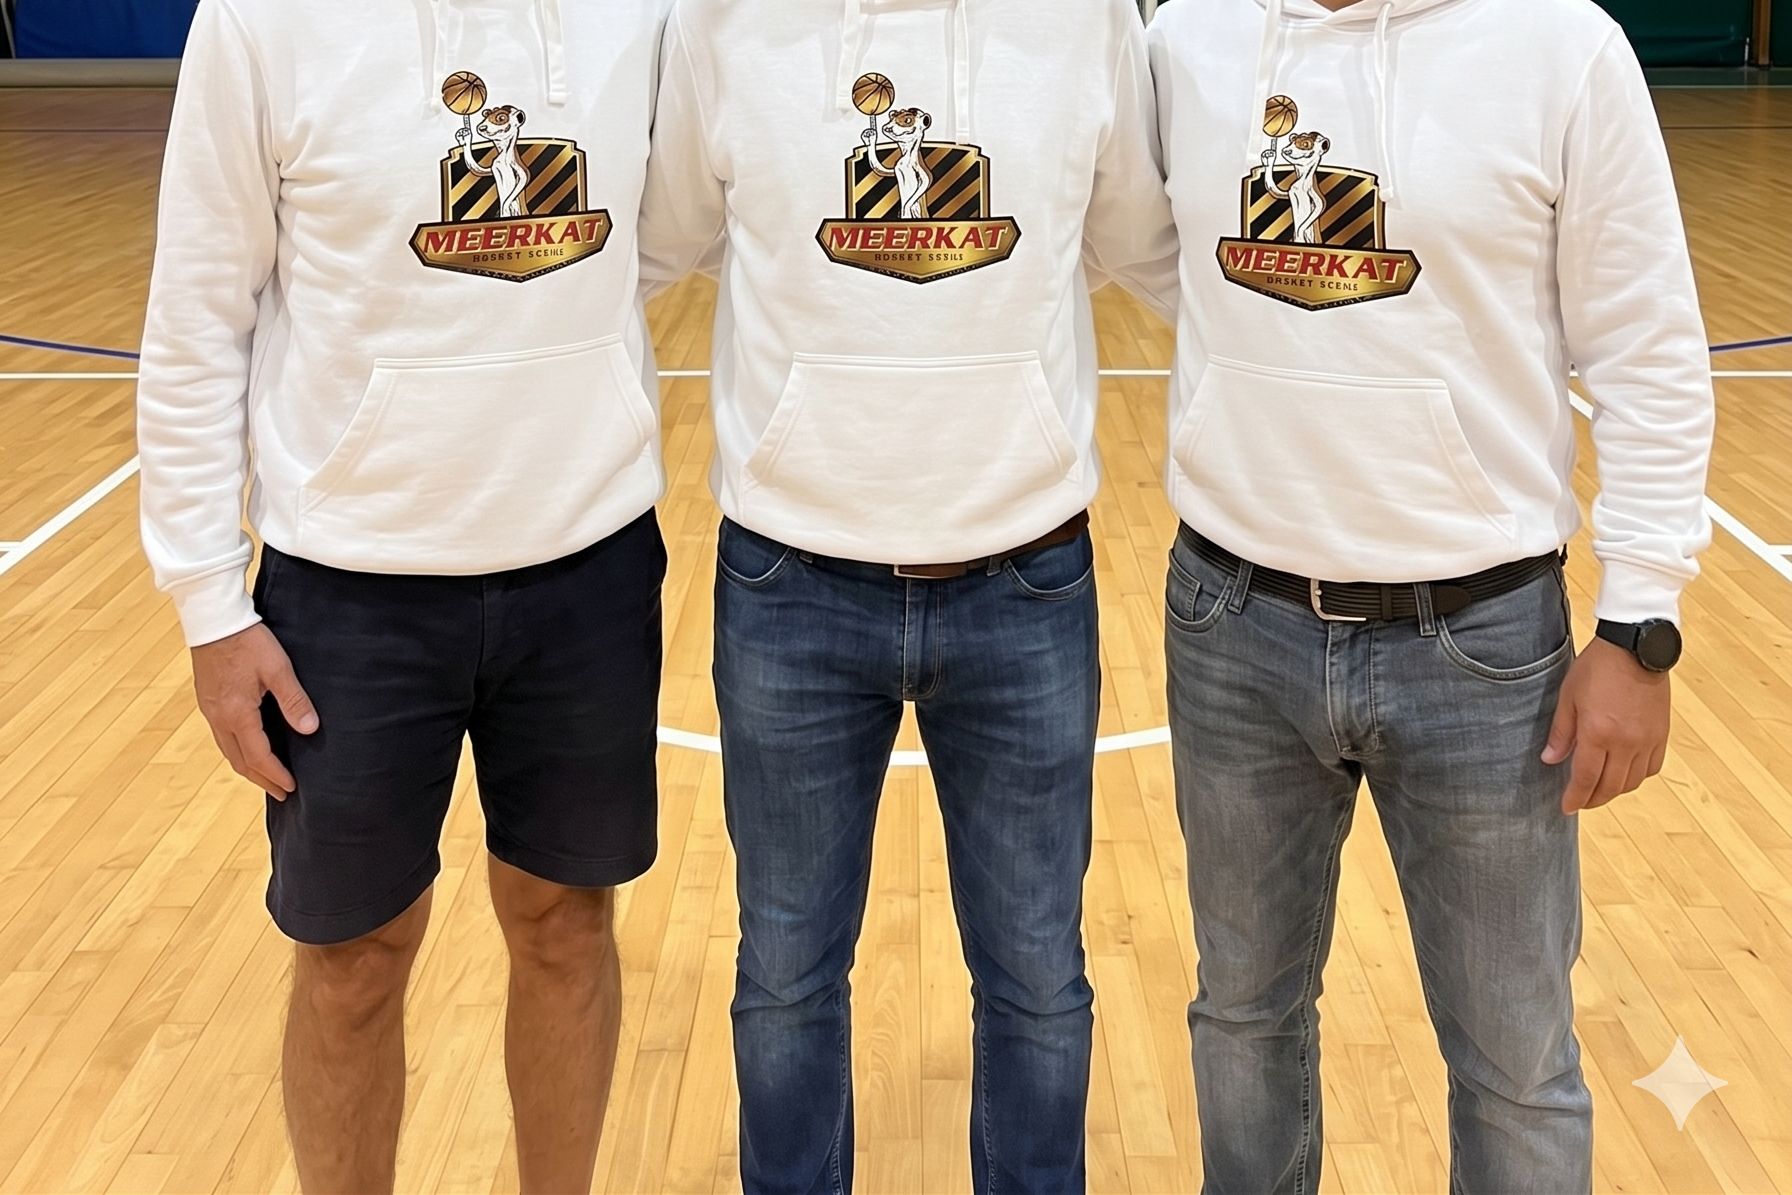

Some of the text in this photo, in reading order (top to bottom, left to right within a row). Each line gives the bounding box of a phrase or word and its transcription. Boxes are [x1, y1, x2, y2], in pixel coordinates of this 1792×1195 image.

[423, 218, 603, 255] MEERKAT
[828, 226, 1009, 252] MEERKAT
[1225, 246, 1407, 283] MEERKAT
